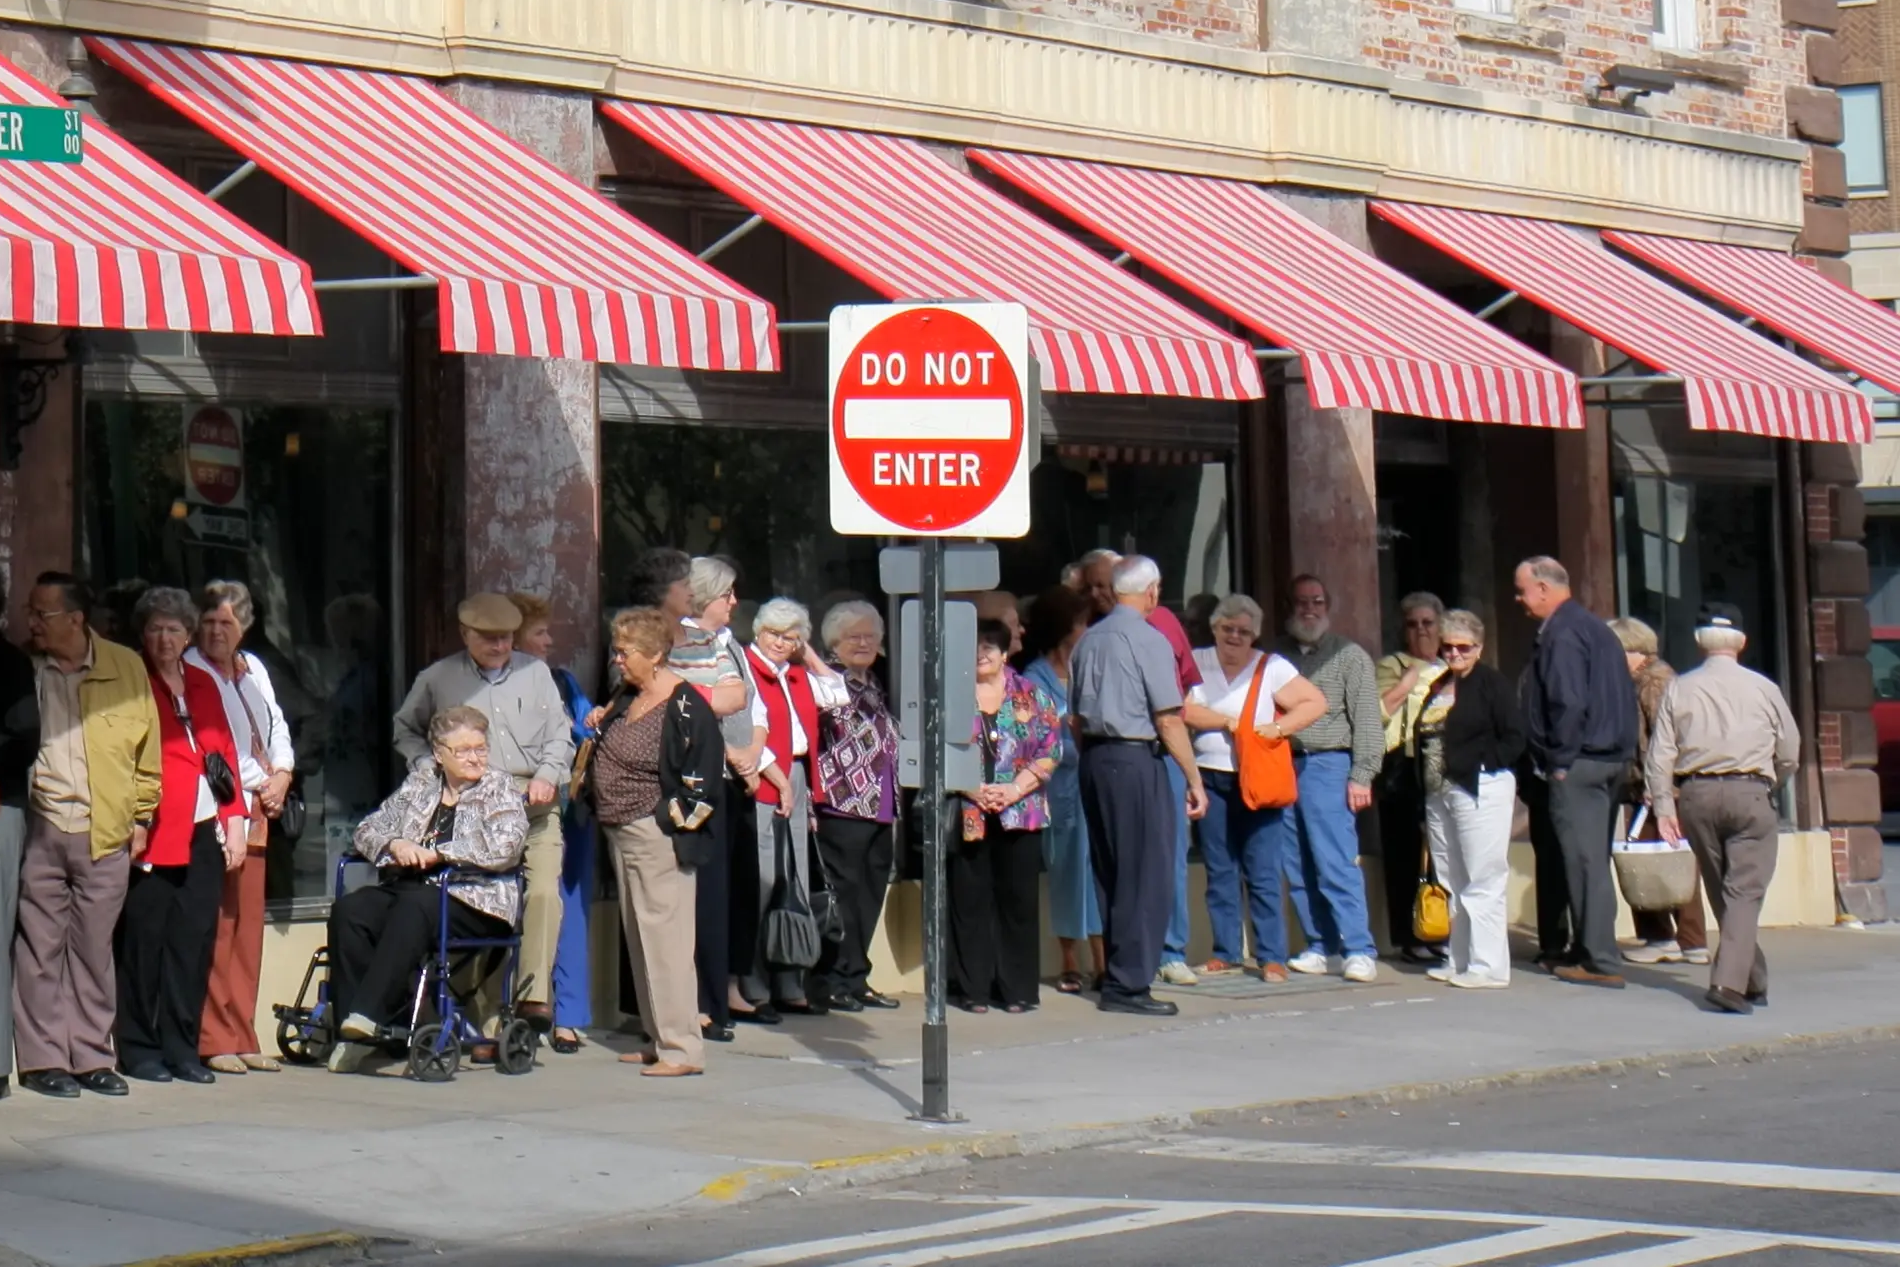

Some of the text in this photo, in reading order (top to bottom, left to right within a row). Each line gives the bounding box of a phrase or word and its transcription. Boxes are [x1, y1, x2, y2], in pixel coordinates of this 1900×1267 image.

[63, 110, 80, 132] ST
[63, 134, 80, 155] 00
[861, 351, 995, 386] DO NOT
[872, 452, 981, 487] ENTER
